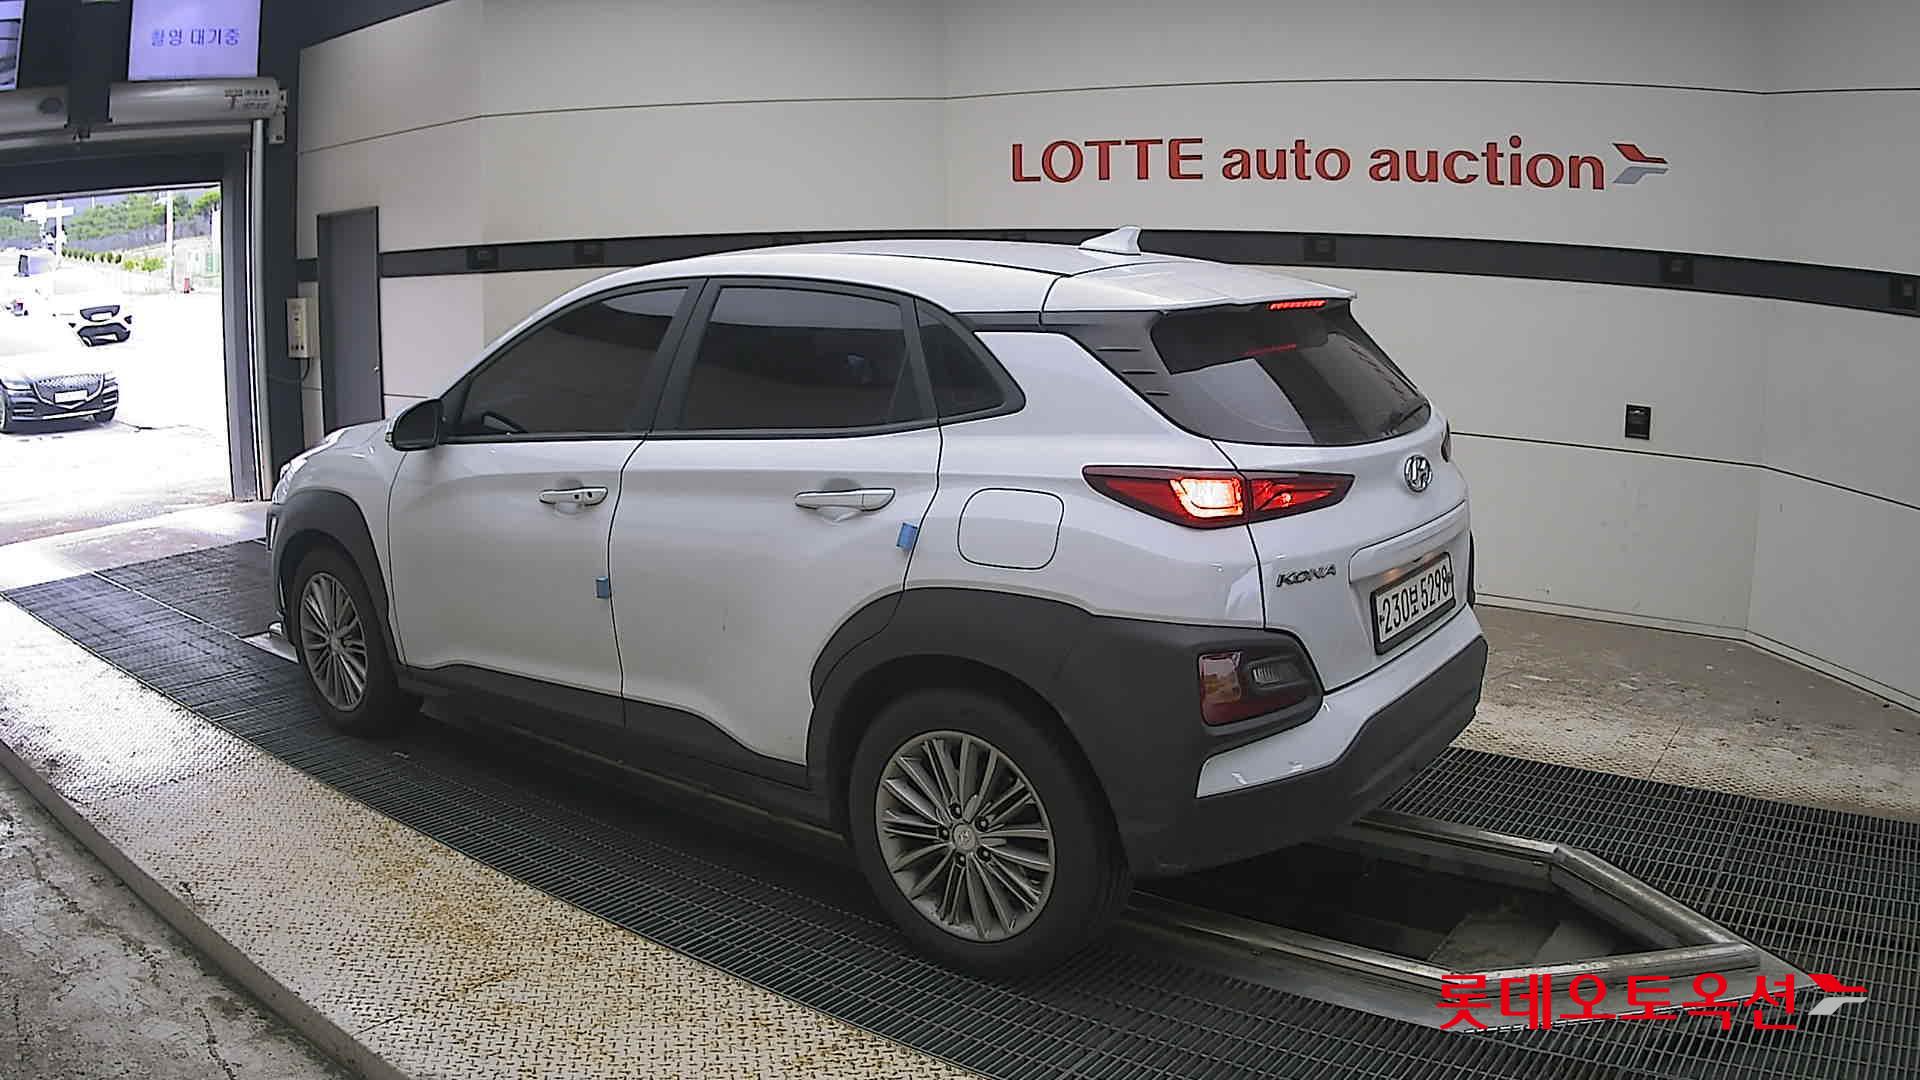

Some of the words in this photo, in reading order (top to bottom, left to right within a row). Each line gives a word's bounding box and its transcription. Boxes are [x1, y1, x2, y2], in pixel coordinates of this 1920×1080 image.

[190, 27, 240, 46] 대기중
[1012, 138, 1204, 183] LOTTE
[1221, 139, 1351, 181] auto
[1368, 135, 1605, 190] auction
[1276, 563, 1337, 588] KONA
